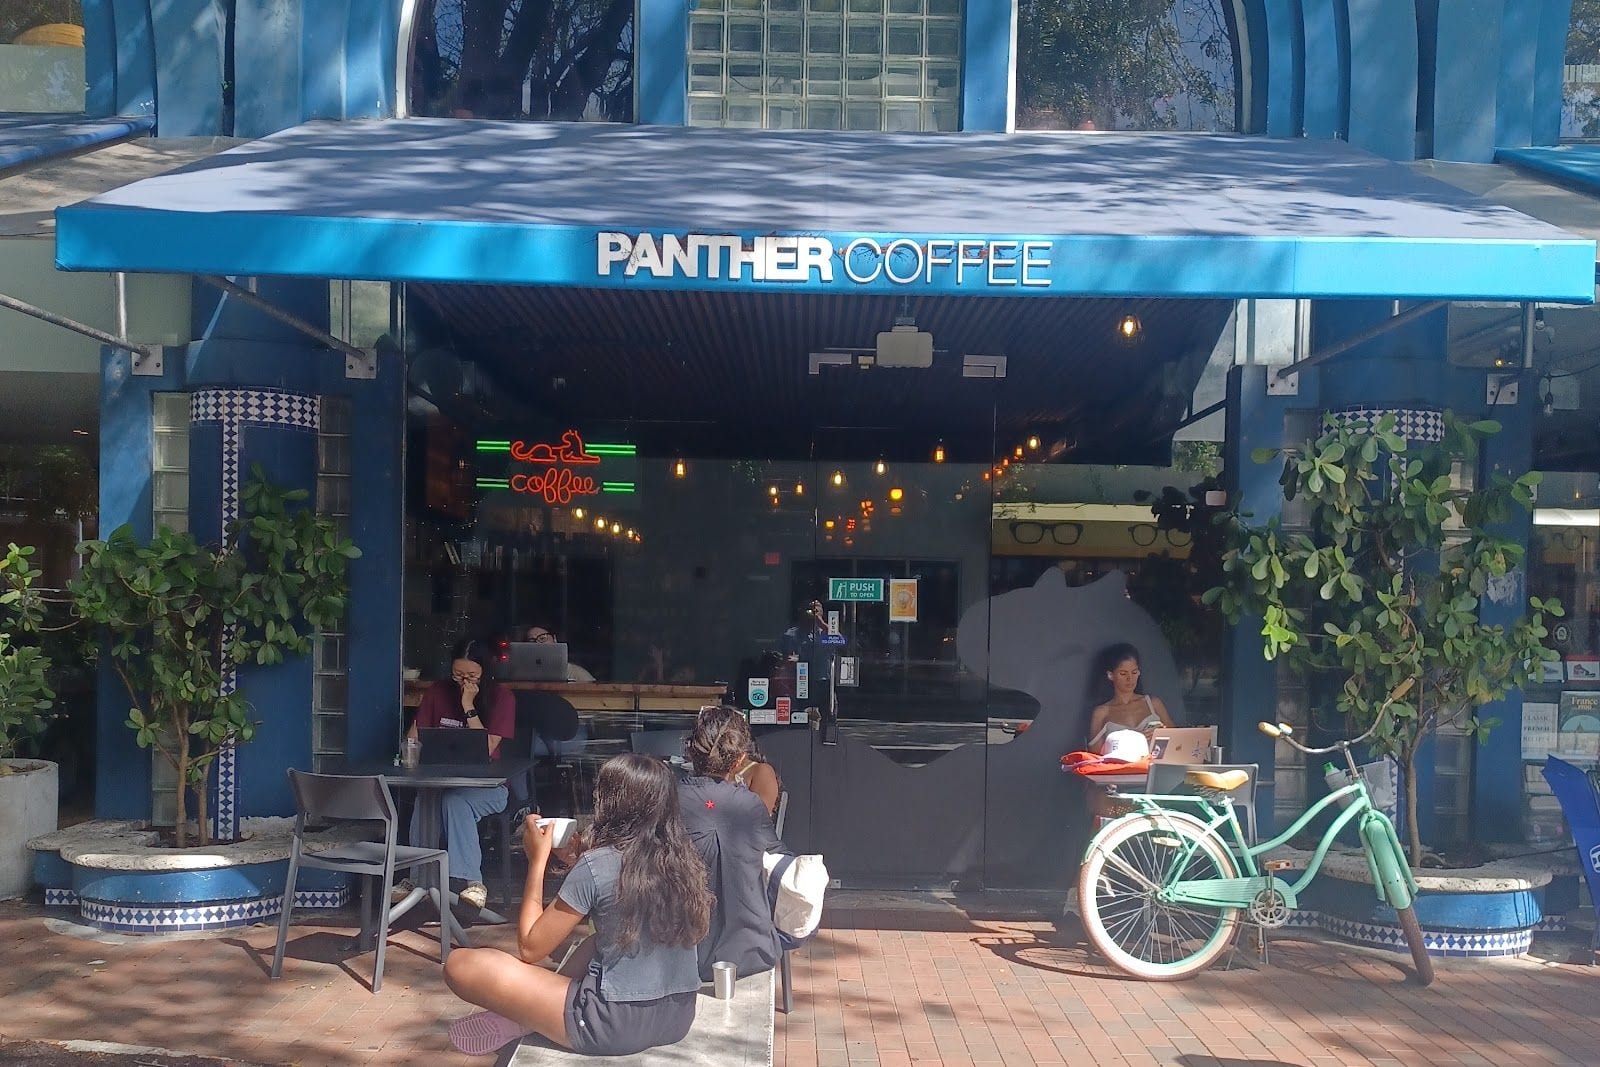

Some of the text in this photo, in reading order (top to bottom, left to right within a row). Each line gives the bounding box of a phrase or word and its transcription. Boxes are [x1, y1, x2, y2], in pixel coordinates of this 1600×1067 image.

[597, 232, 1053, 285] PANTHER COFFEE
[511, 467, 600, 503] coffee
[850, 582, 875, 591] PUSH
[1571, 697, 1598, 705] France
